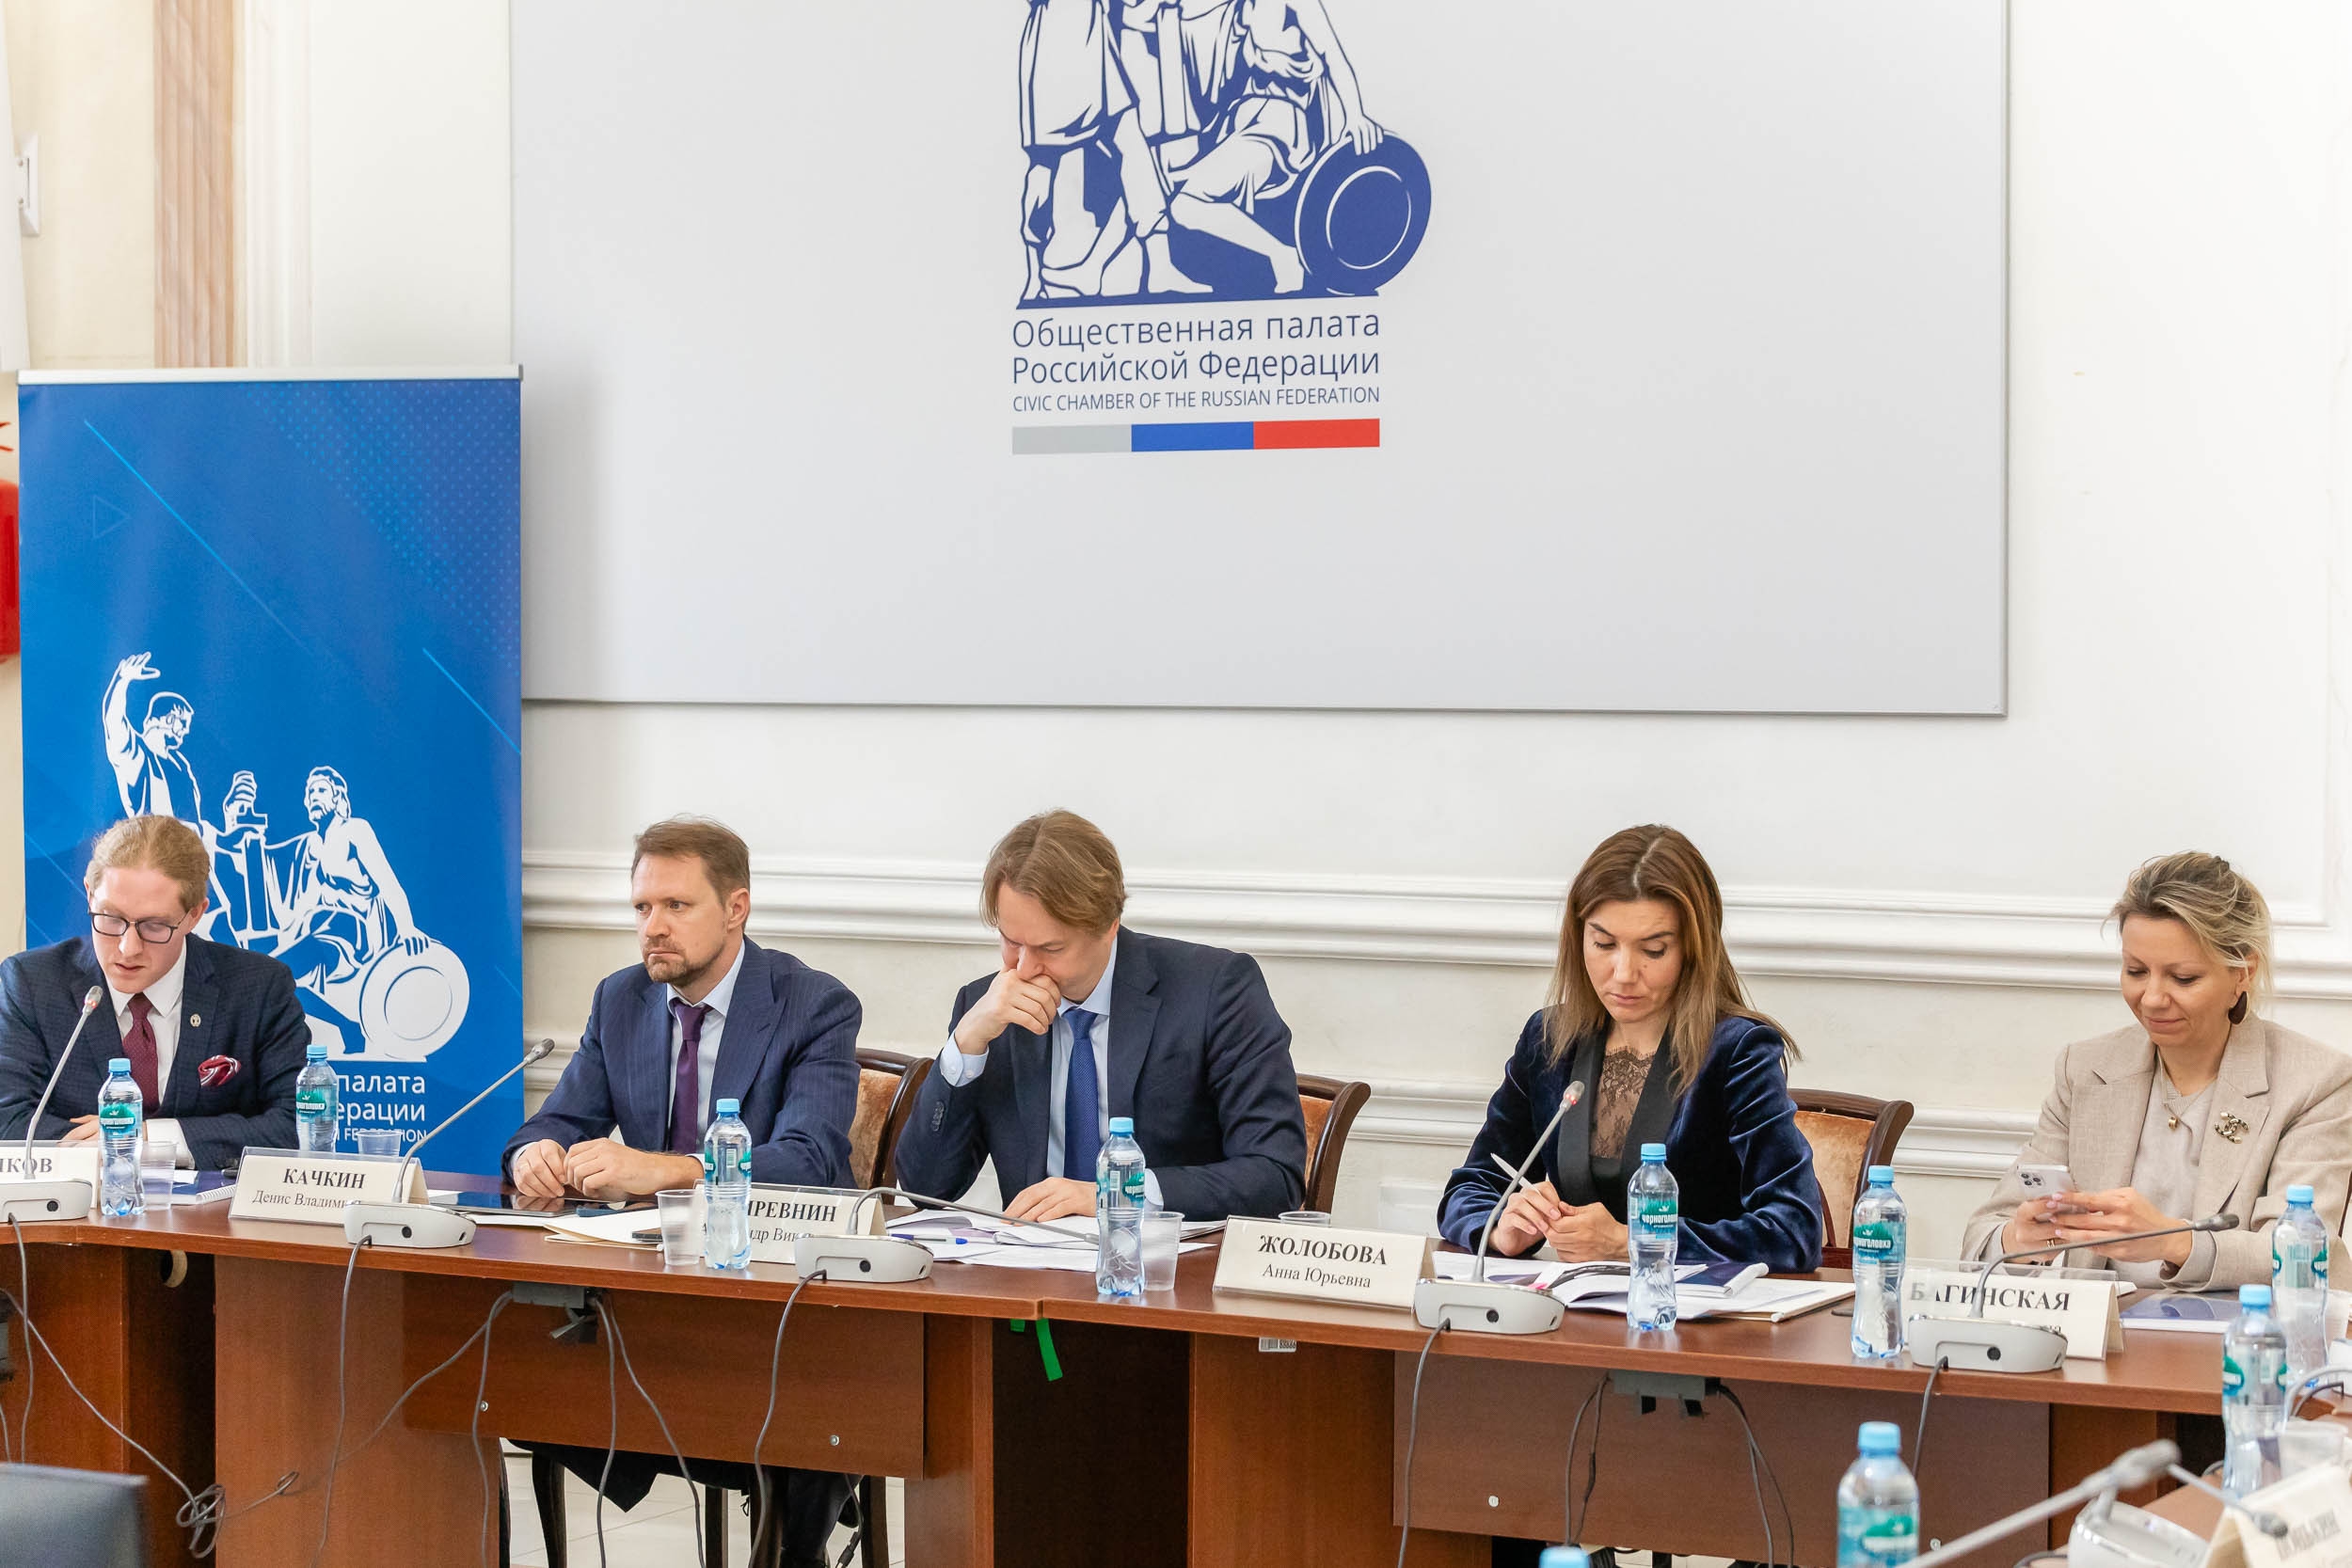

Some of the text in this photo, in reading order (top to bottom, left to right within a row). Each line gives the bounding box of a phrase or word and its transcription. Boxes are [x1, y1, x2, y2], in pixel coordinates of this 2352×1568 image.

[1012, 313, 1380, 353] Общественная палата
[1013, 350, 1380, 385] Российской Федерации
[1012, 386, 1380, 412] CIVIC CHAMBER OF THE RUSSIAN FEDERATION
[337, 1074, 426, 1094] палата
[337, 1102, 426, 1126] ерации
[282, 1167, 366, 1190] КАЧКИН
[252, 1190, 291, 1205] Денис
[1258, 1234, 1387, 1266] ЖОЛОБОВА
[1263, 1263, 1372, 1289] Анна Юрьевна
